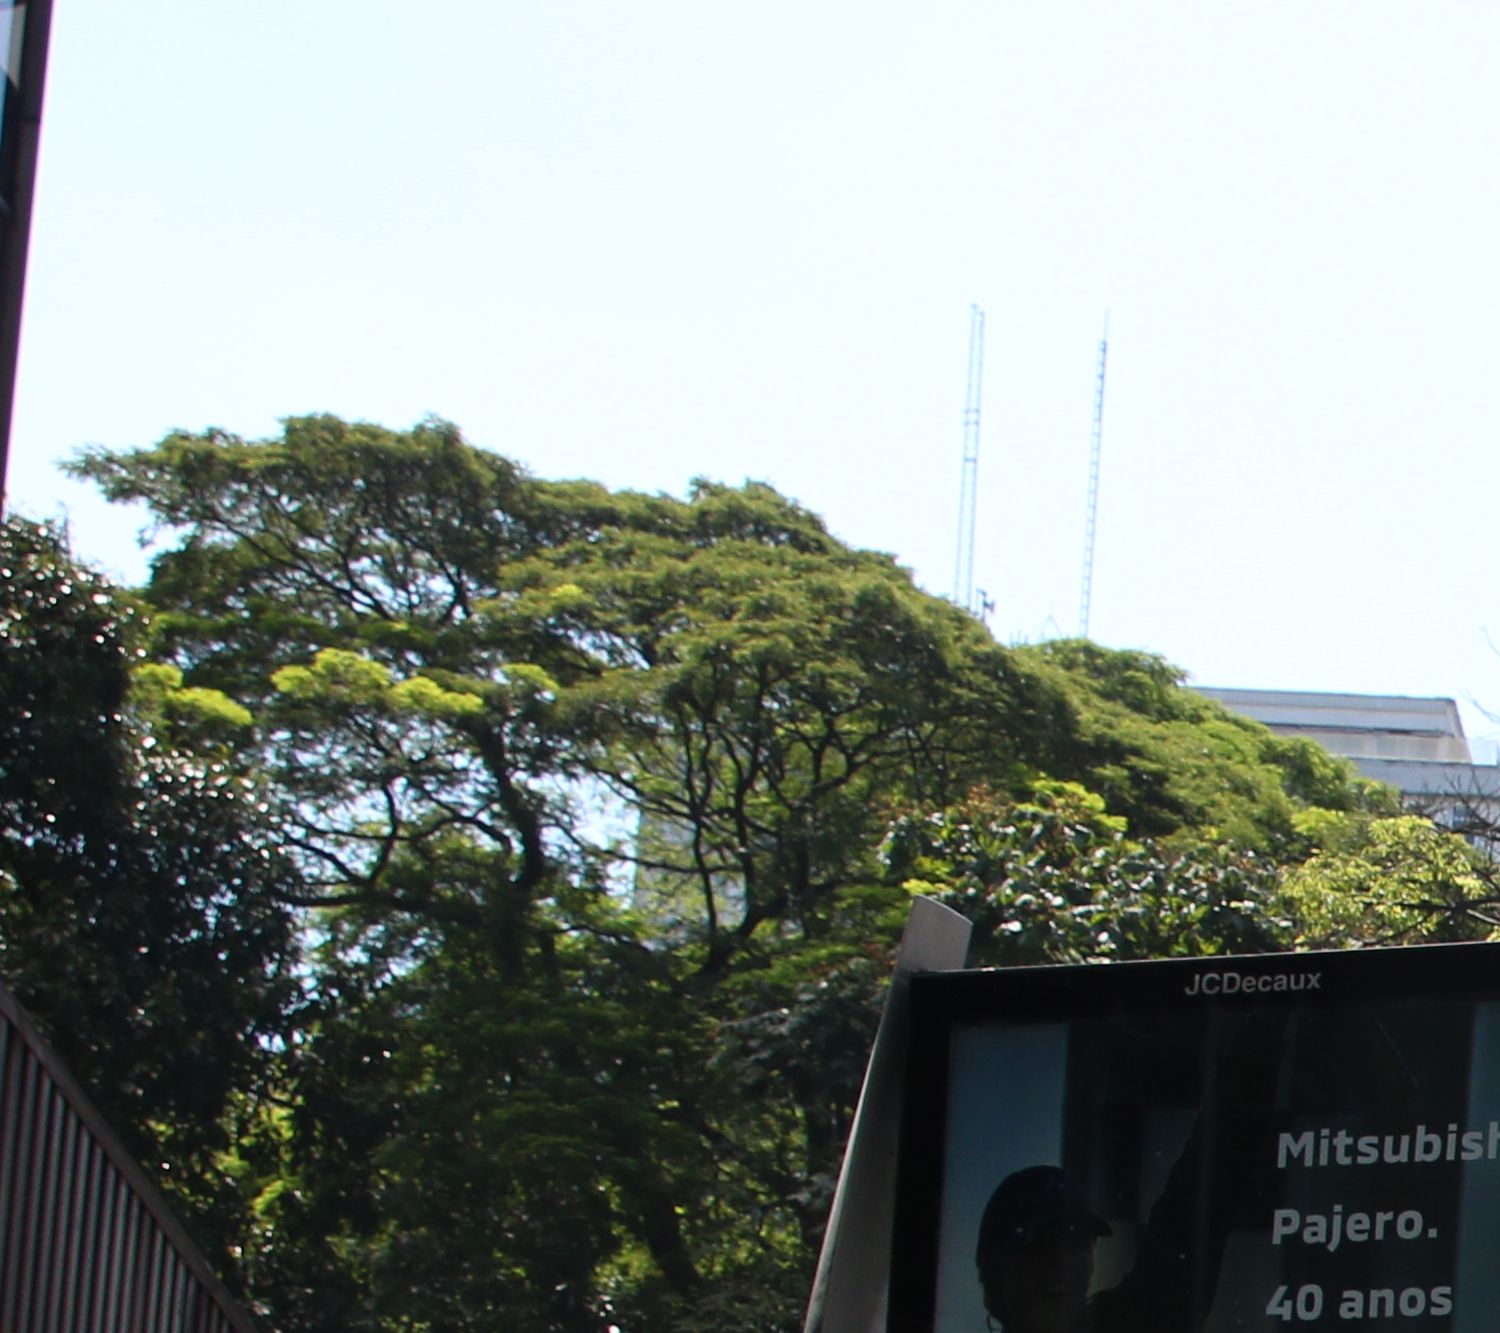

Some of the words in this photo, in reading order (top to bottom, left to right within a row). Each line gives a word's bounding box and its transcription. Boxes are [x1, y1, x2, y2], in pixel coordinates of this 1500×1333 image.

[1184, 967, 1321, 997] JCDecaux
[1272, 1207, 1438, 1252] Pajero.
[1266, 1282, 1323, 1321] 40
[1338, 1279, 1453, 1318] anos
